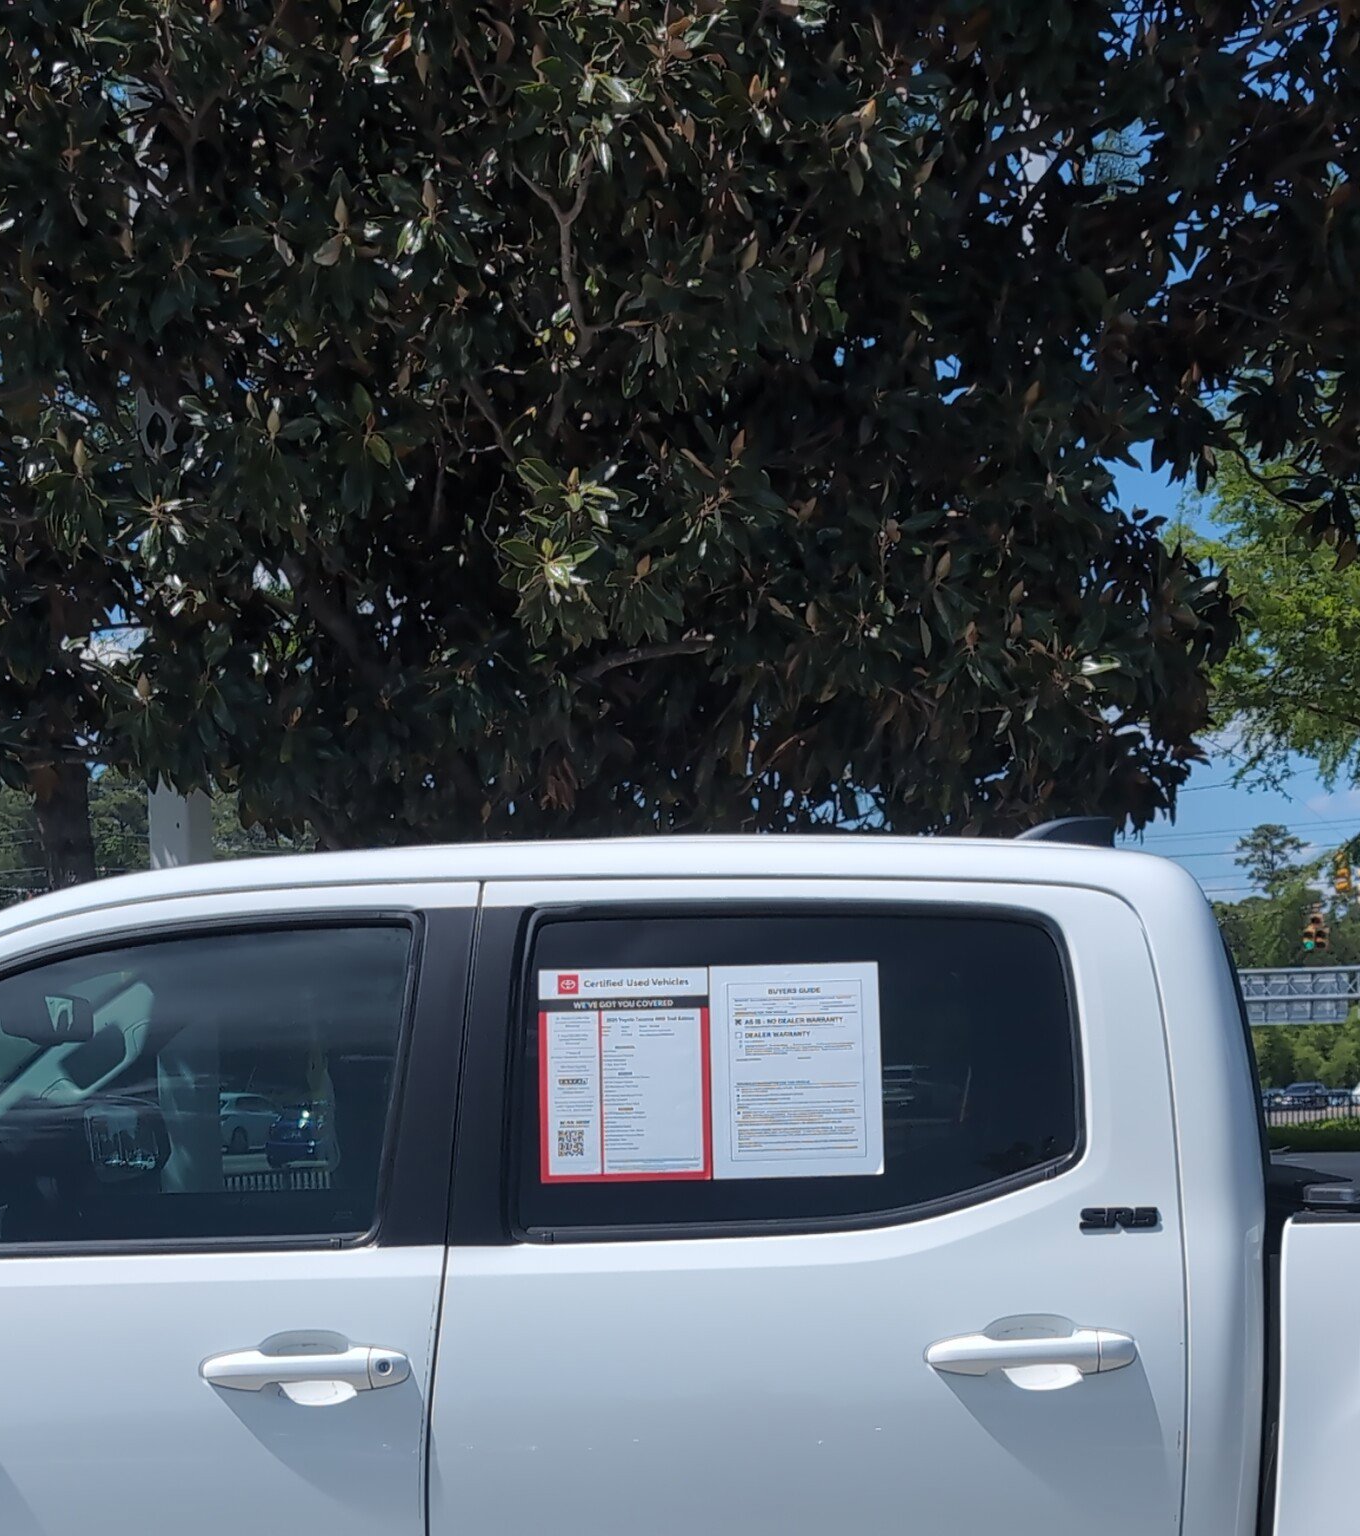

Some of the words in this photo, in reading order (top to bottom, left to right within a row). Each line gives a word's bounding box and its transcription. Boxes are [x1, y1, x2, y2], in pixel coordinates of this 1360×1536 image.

[583, 979, 623, 988] Certified
[626, 978, 649, 987] Used
[651, 977, 689, 986] Vehicles
[767, 987, 797, 995] BUYERS
[798, 986, 821, 994] GUIDE
[573, 1001, 598, 1009] WE'VE
[599, 1000, 616, 1008] GOT
[616, 1000, 635, 1008] YOU
[636, 999, 674, 1008] COVERED
[744, 1018, 754, 1026] AS
[778, 1017, 804, 1025] DEALER
[806, 1016, 843, 1024] WARRANTY
[744, 1031, 771, 1039] DEALER
[773, 1030, 811, 1038] WARRANTY
[1078, 1206, 1159, 1230] SR5
